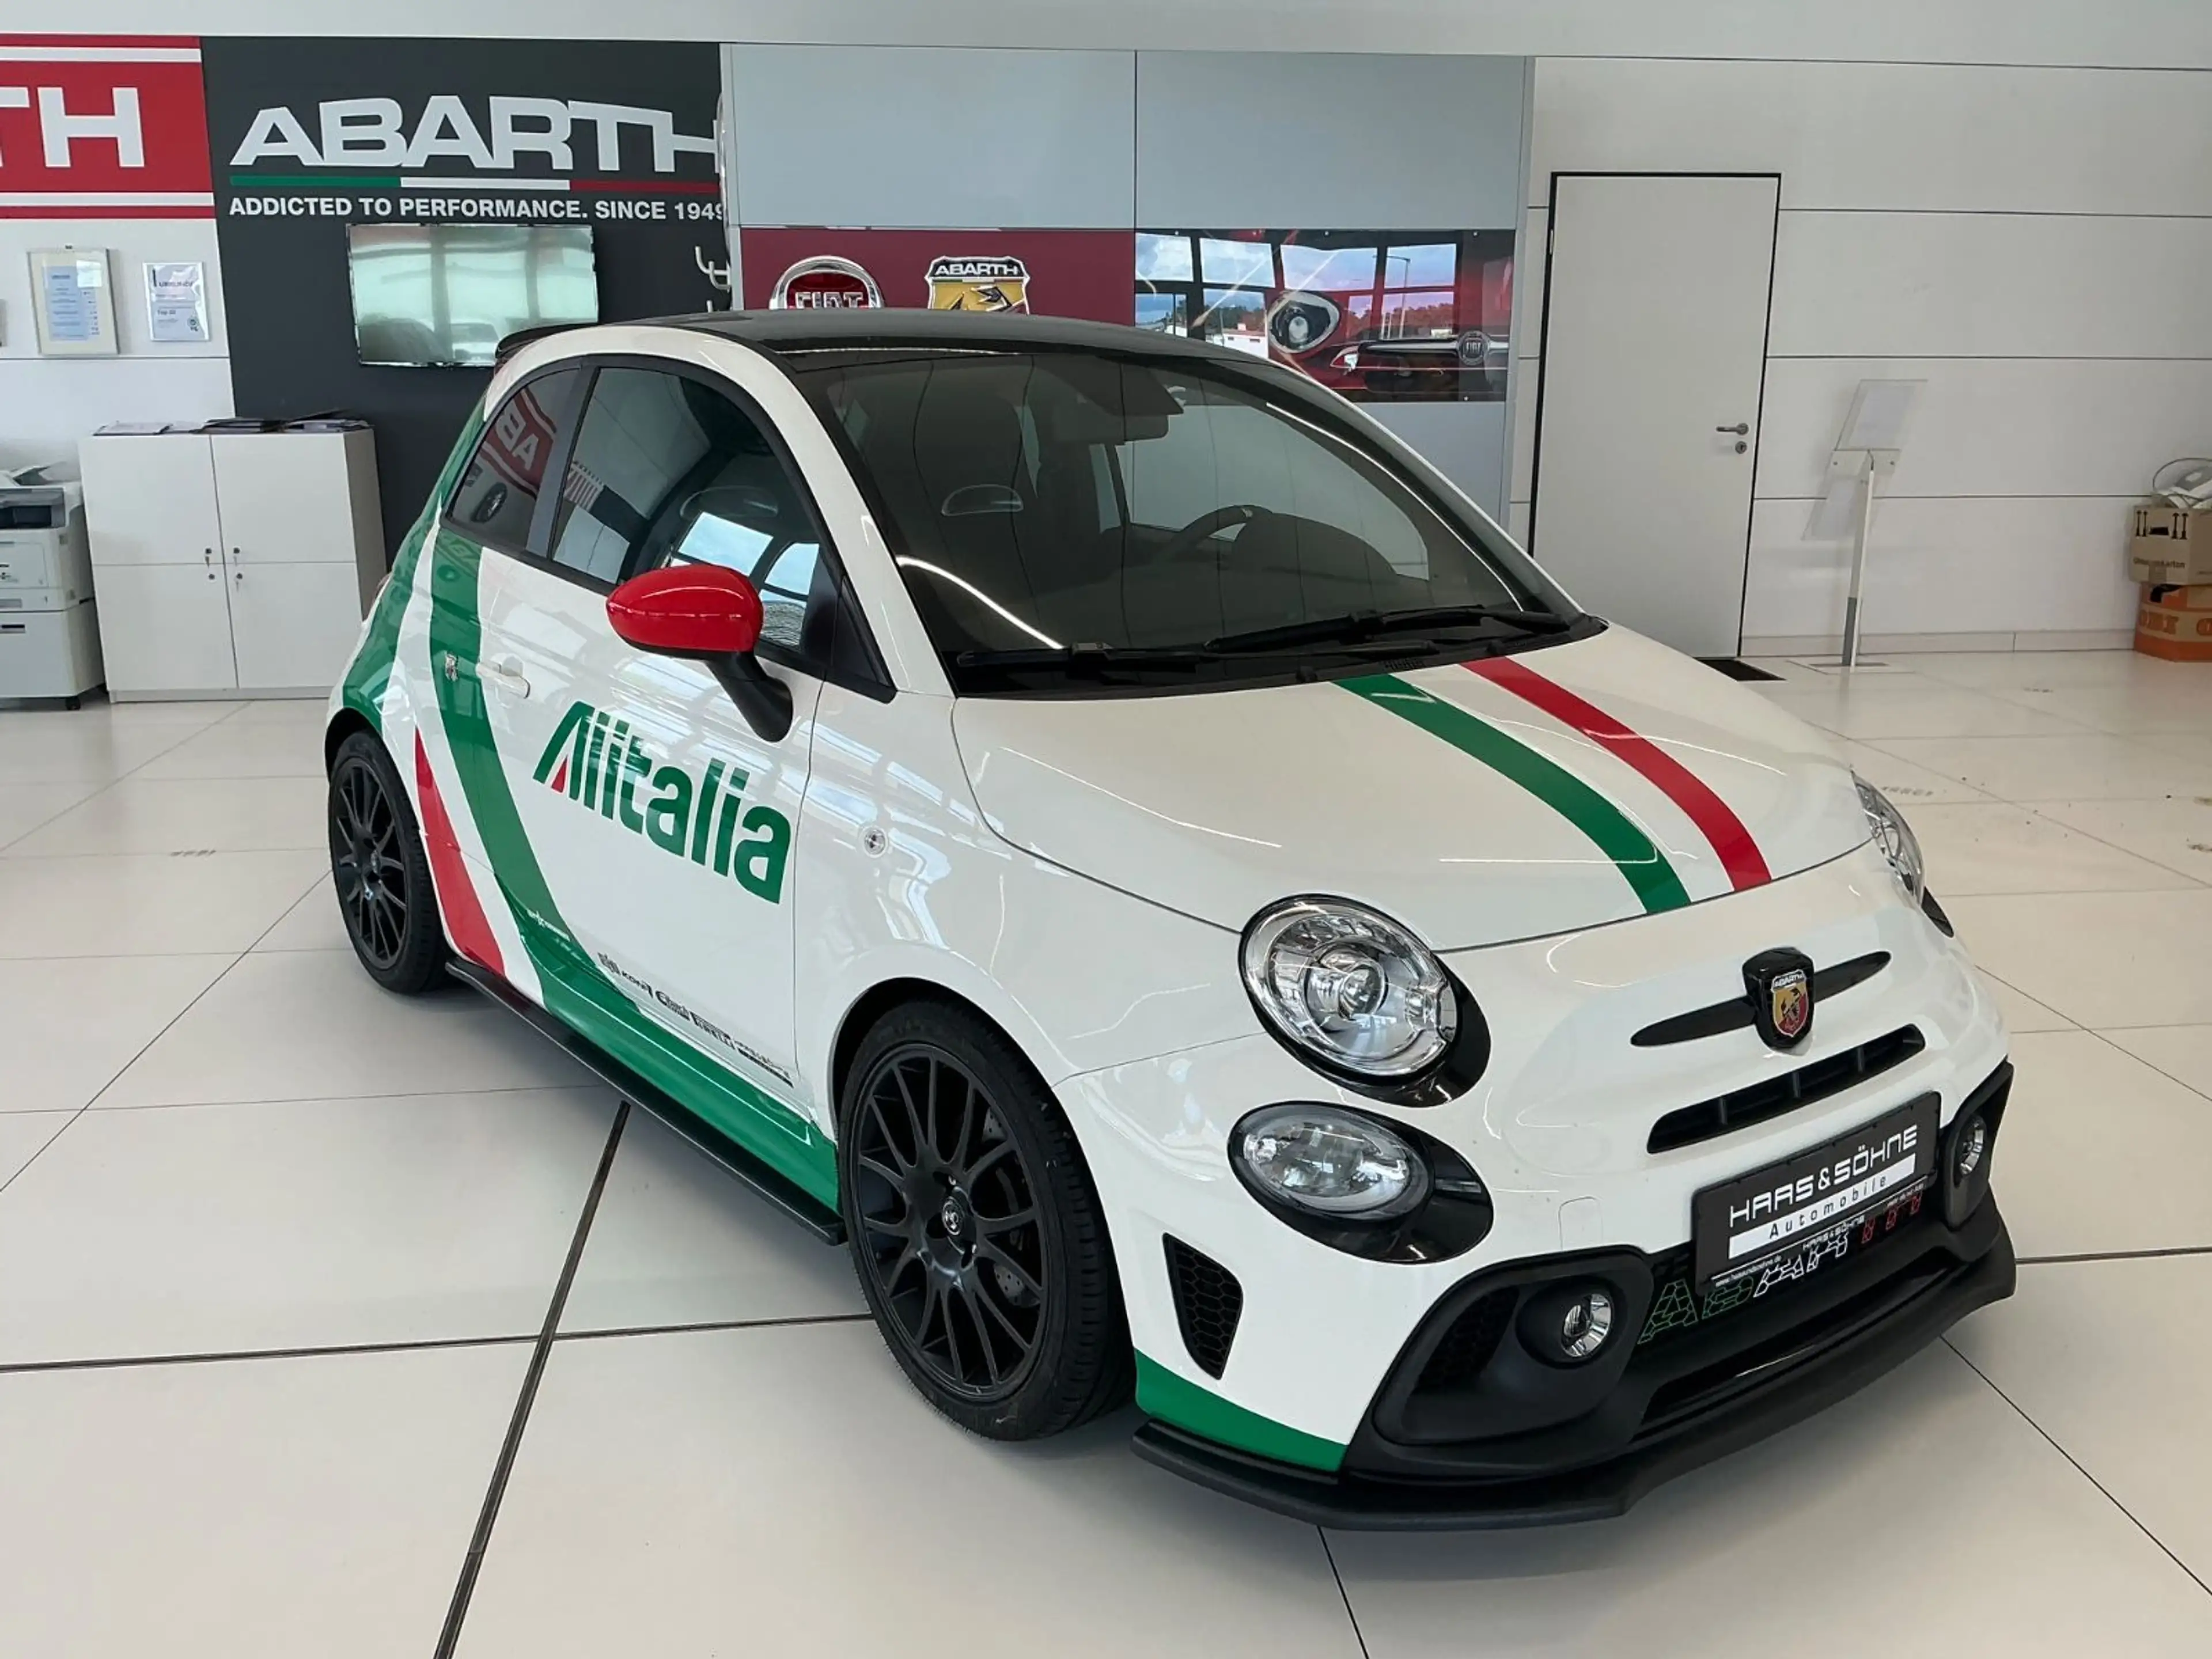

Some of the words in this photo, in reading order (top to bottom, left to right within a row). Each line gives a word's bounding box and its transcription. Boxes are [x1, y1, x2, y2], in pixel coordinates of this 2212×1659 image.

[230, 95, 720, 174] ABARTH
[229, 197, 353, 217] ADDICTED
[358, 198, 392, 217] TO
[399, 199, 588, 218] PERFORMANCE.
[594, 200, 666, 219] SINCE
[674, 202, 724, 221] 1949
[934, 262, 1018, 275] ABARTH
[532, 700, 791, 904] Alitalia
[1769, 1174, 1887, 1239] Automobile
